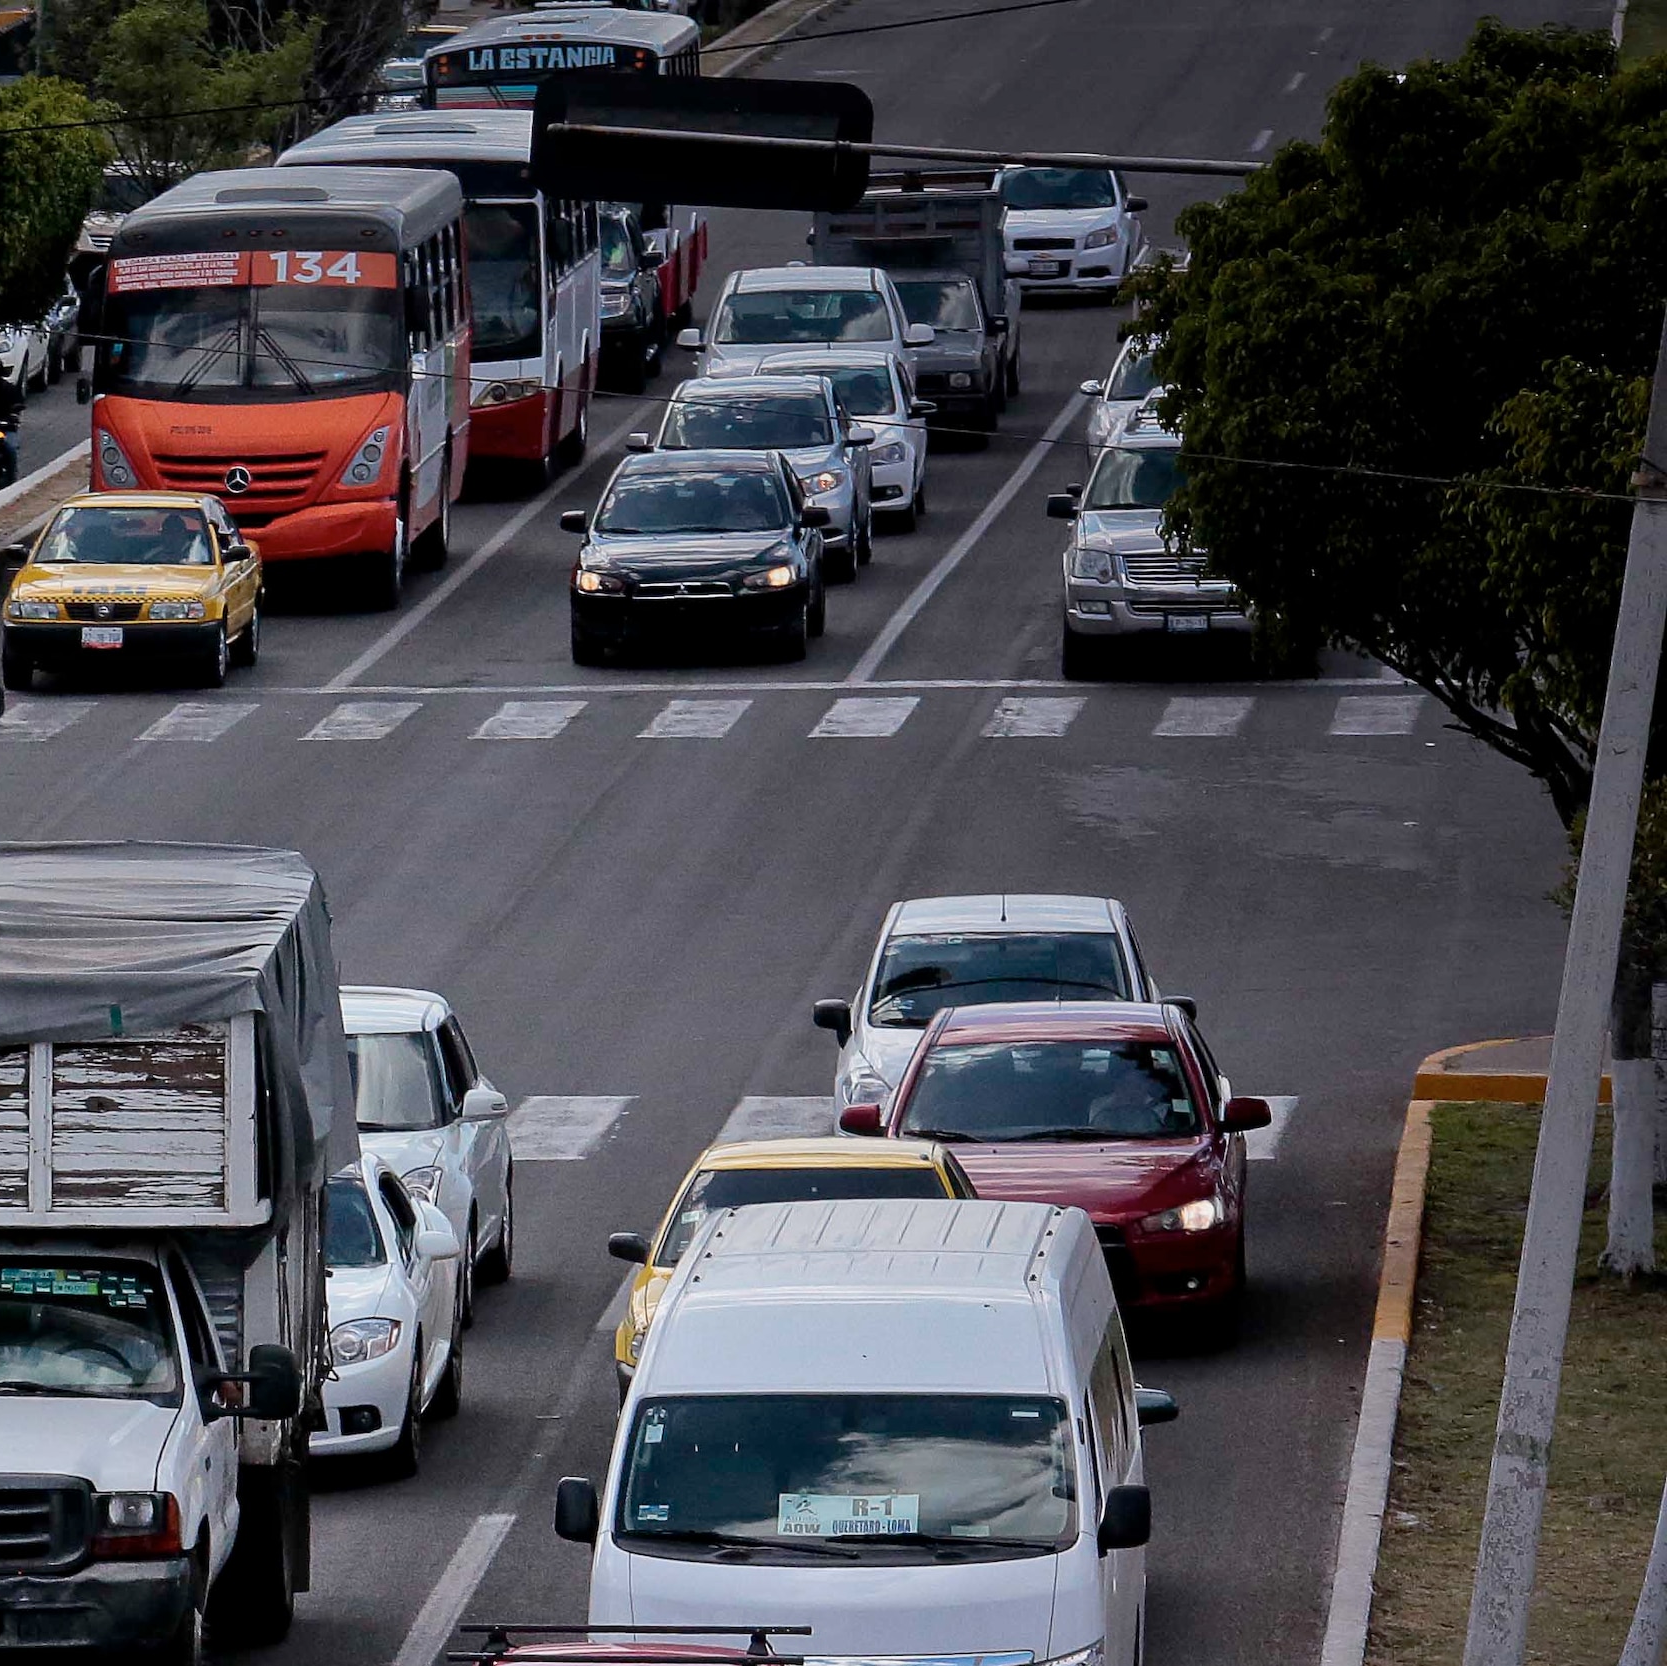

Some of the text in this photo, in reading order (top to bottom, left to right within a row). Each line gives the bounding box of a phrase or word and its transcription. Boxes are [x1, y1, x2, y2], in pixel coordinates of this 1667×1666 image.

[468, 46, 616, 71] LA ESTANCIA
[269, 251, 363, 284] 134
[852, 1498, 893, 1516] R-1
